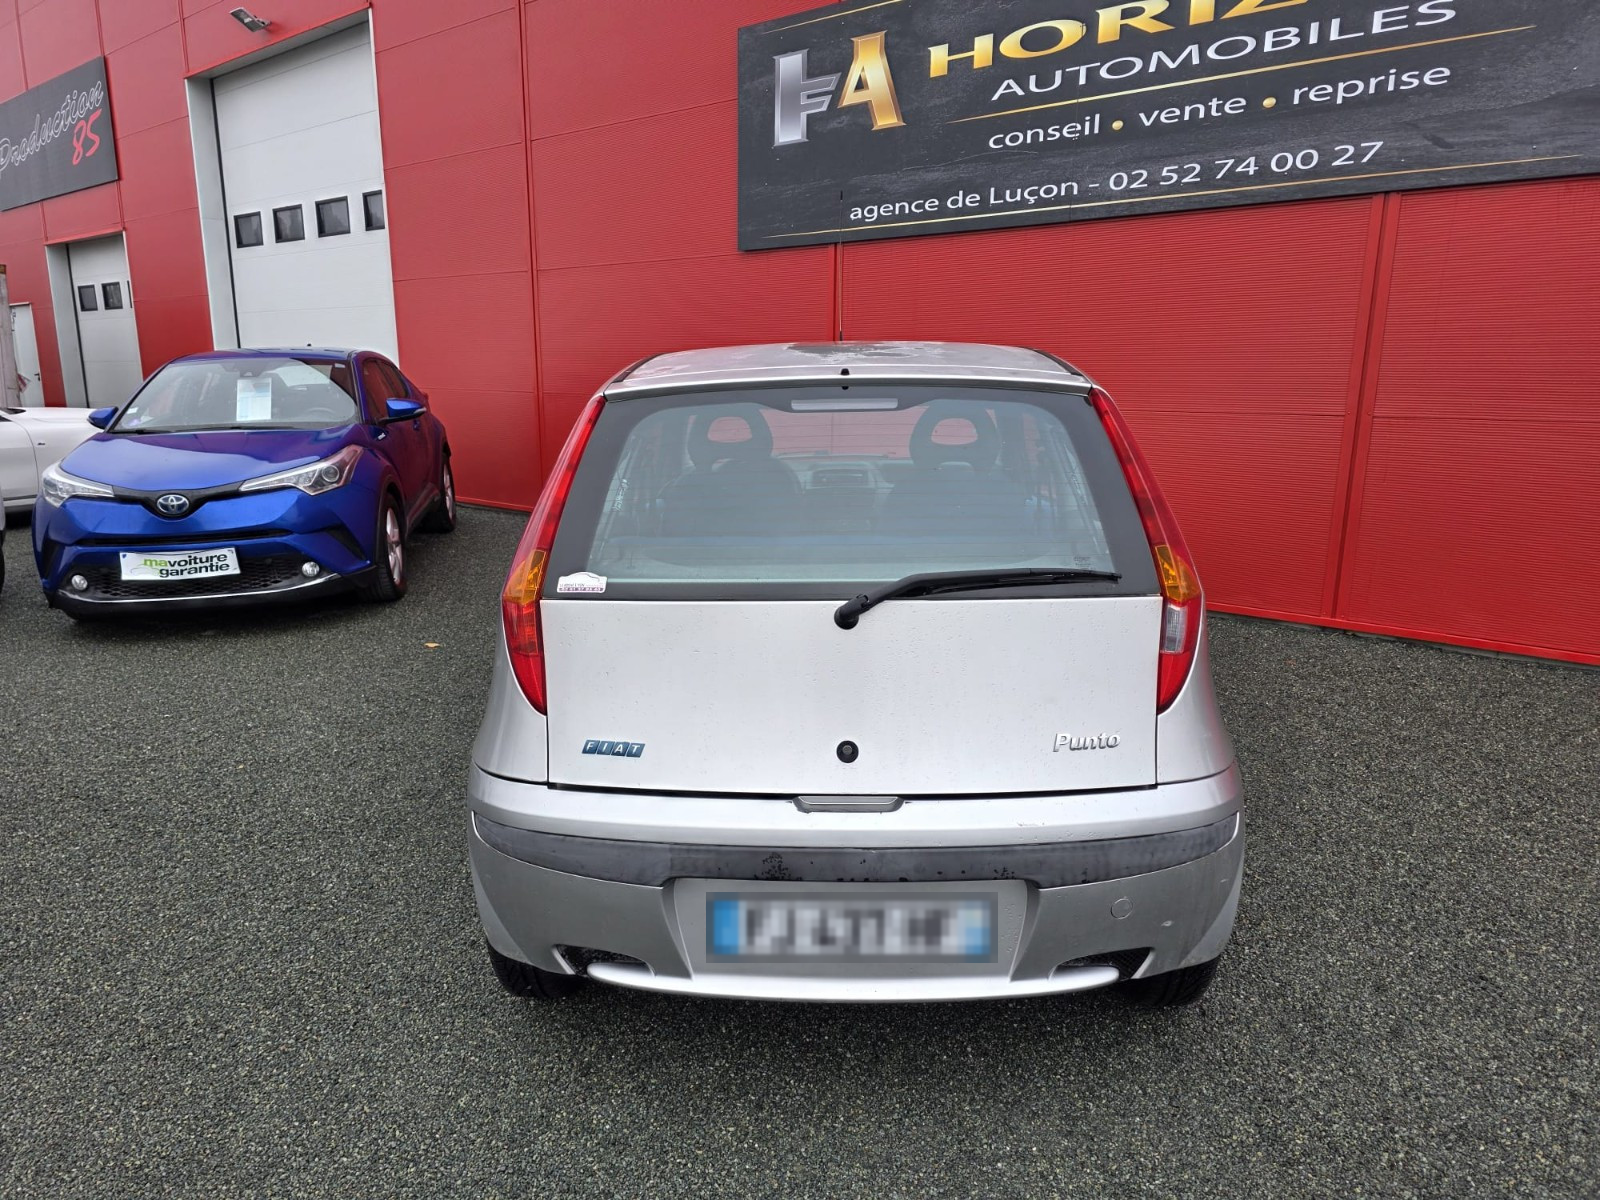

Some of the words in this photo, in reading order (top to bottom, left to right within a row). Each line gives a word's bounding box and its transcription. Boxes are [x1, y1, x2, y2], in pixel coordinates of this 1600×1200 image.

[928, 0, 1308, 78] HORI
[991, 0, 1456, 101] AUTOMOBILES
[72, 108, 102, 166] 85
[988, 113, 1100, 149] conseil
[1138, 97, 1247, 127] vente
[1293, 67, 1451, 105] reprise
[849, 198, 939, 222] agence
[946, 190, 981, 209] de
[989, 180, 1078, 207] Luçon
[1108, 169, 1148, 191] 02
[1159, 163, 1201, 185] 52
[1214, 156, 1259, 180] 74
[1270, 149, 1319, 173] 00
[1331, 141, 1384, 166] 27
[159, 561, 230, 578] garantie
[585, 740, 642, 756] FIAT
[1052, 732, 1121, 753] Punto
